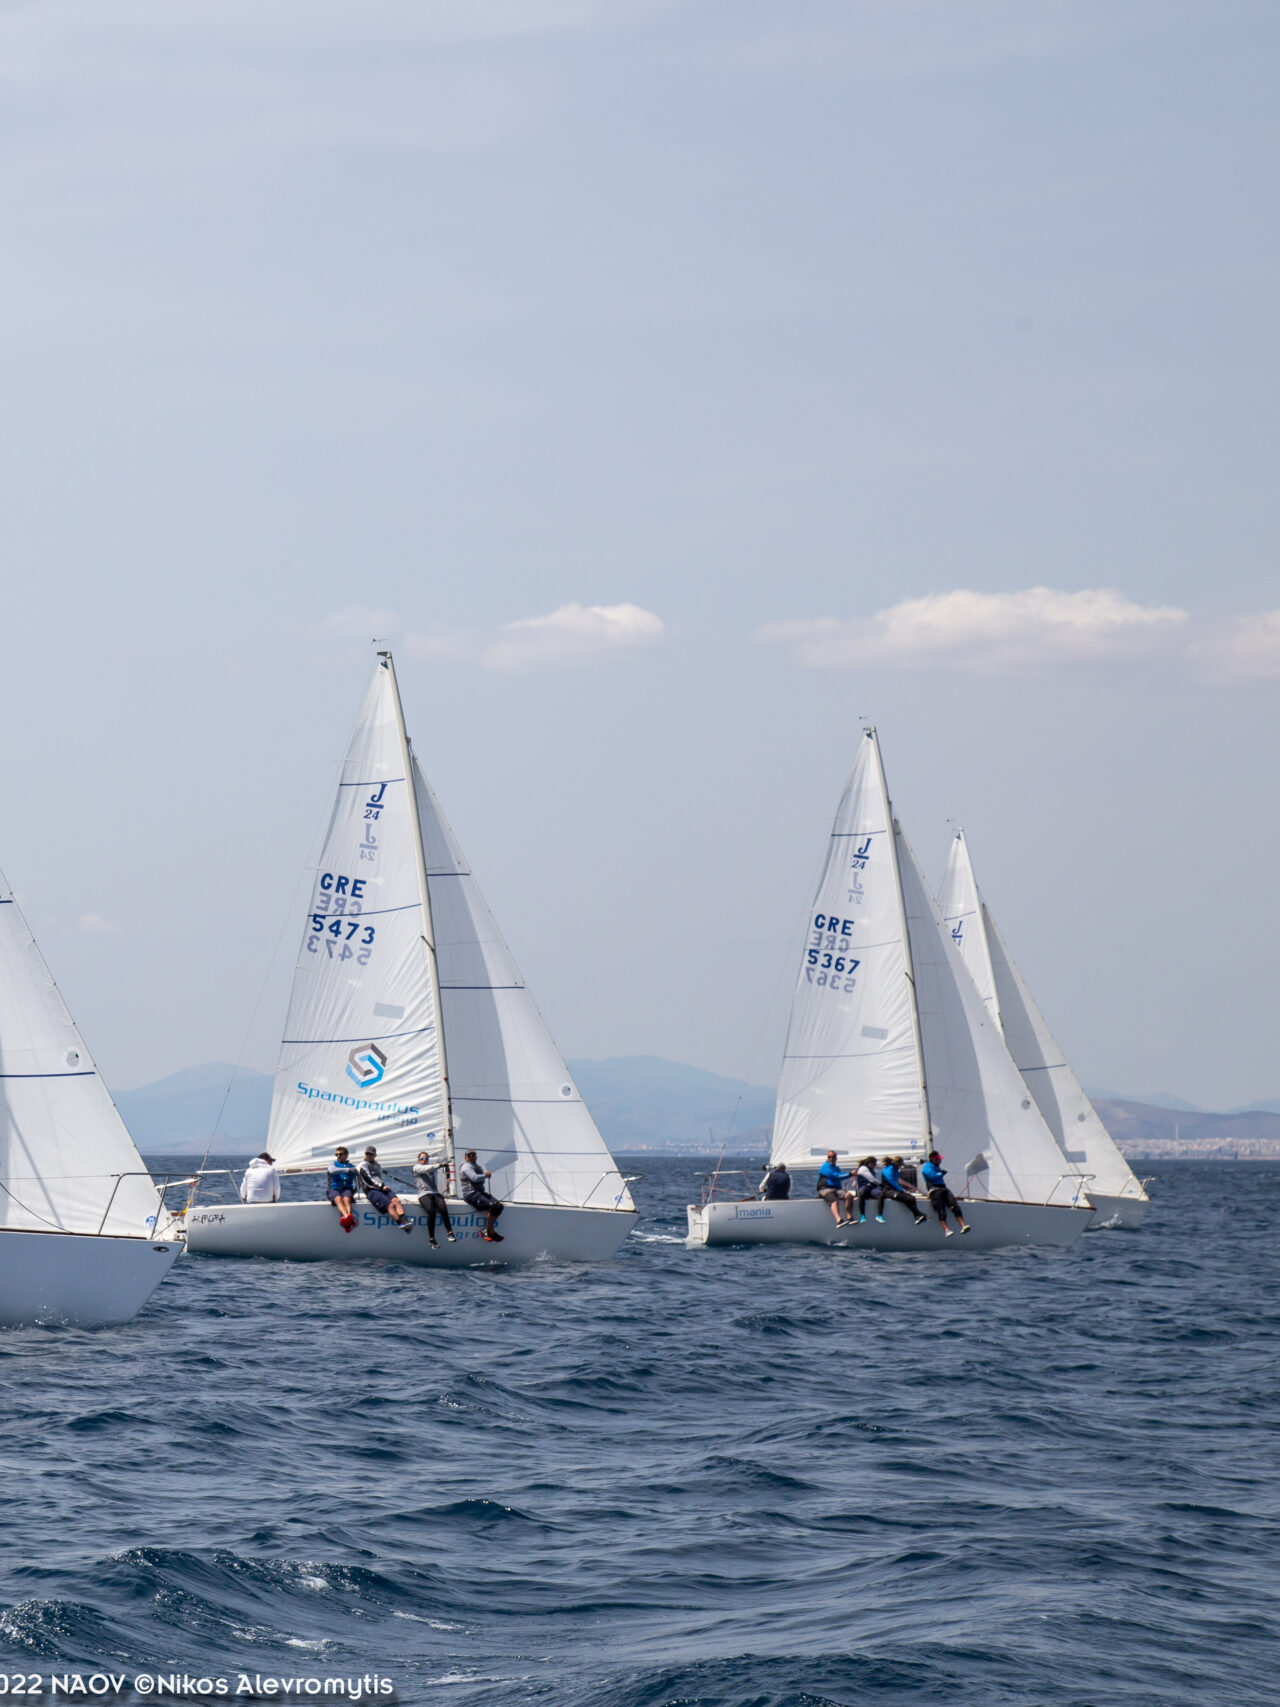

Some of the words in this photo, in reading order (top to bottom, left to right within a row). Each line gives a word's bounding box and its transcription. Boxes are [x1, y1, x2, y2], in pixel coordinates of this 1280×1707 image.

[370, 783, 387, 802] J
[363, 809, 380, 821] 24
[857, 838, 872, 854] J
[851, 859, 866, 869] 24
[320, 872, 367, 899] GRE
[312, 914, 376, 945] 5473
[814, 913, 855, 937] GRE
[952, 920, 963, 935] J
[807, 949, 861, 975] 5367
